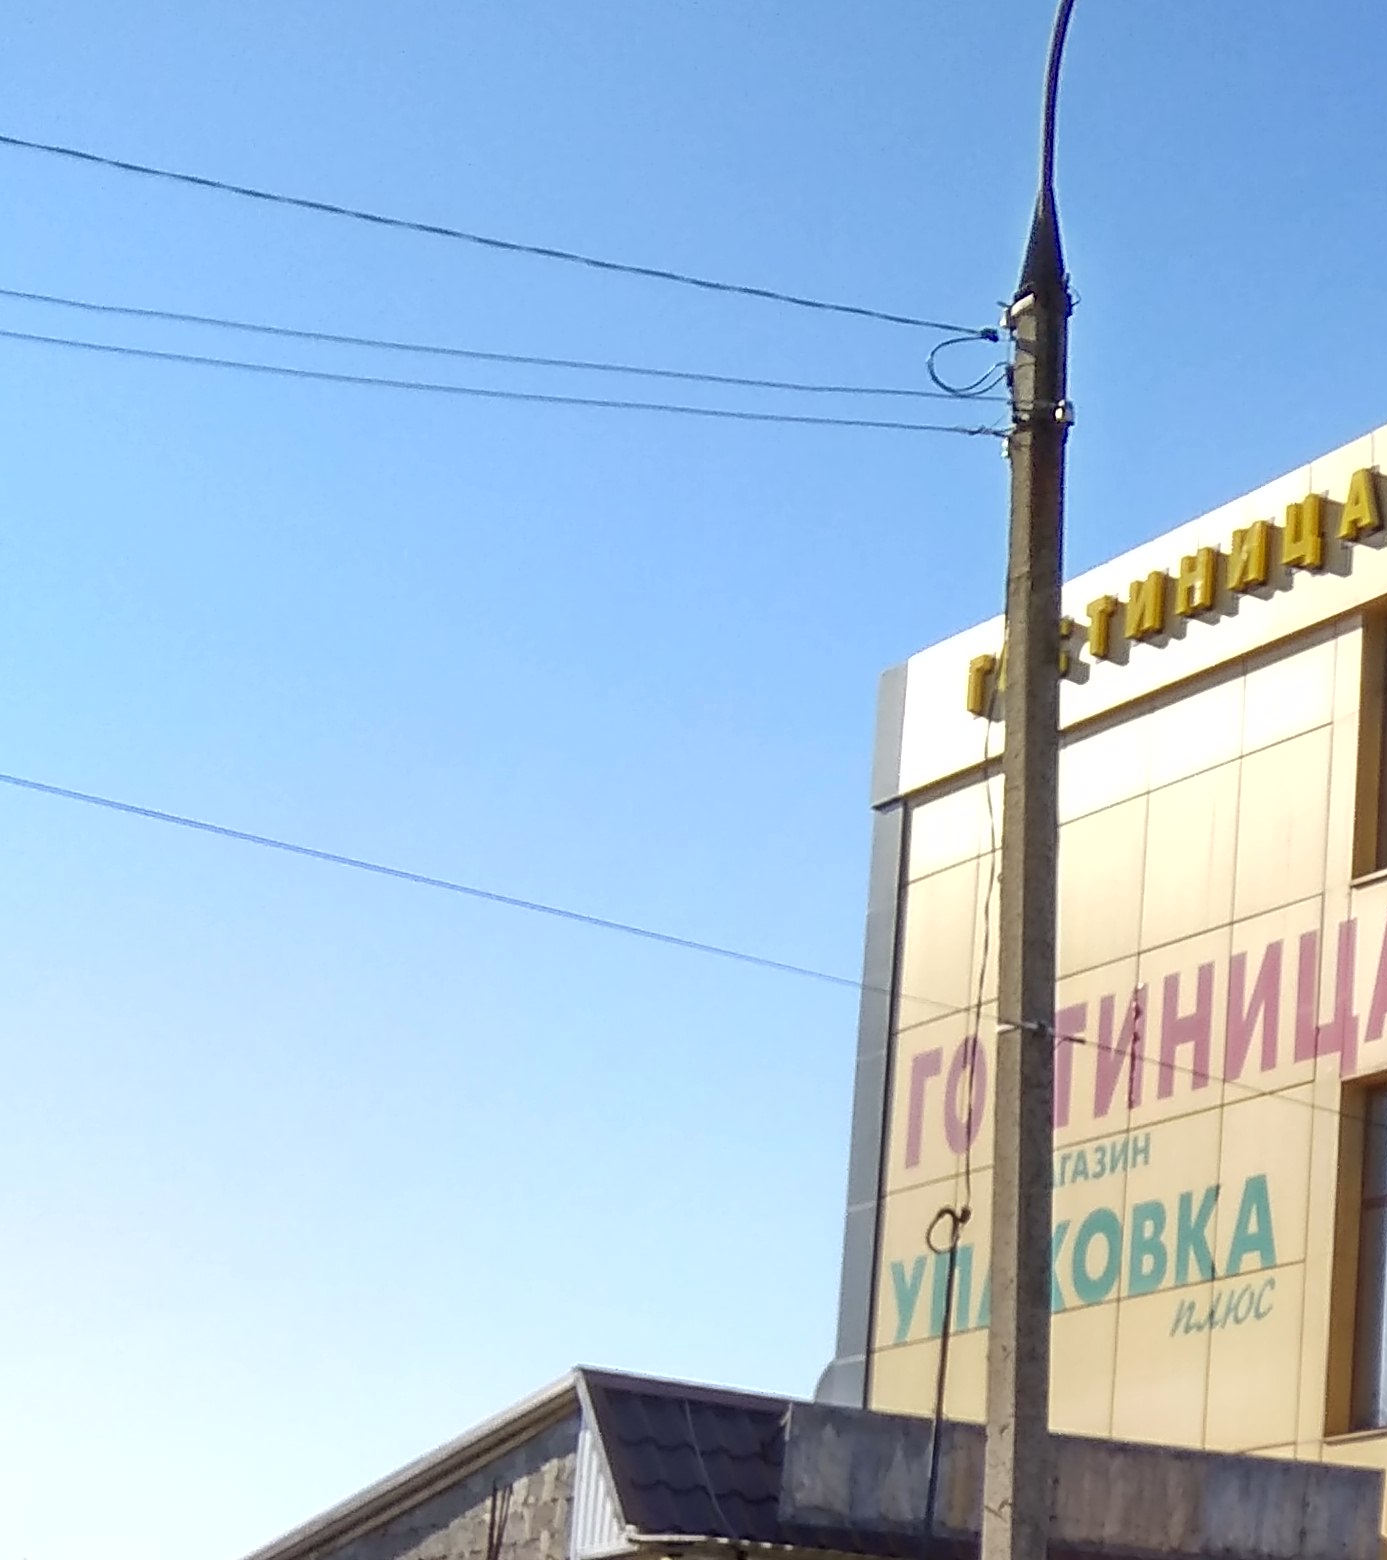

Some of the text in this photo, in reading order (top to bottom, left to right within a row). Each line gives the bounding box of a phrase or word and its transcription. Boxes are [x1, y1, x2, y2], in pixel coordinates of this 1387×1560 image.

[966, 467, 1384, 717] ГТИНИЦА
[1052, 1132, 1151, 1188] ГАЗИН
[890, 1173, 1277, 1346] УПОВКА
